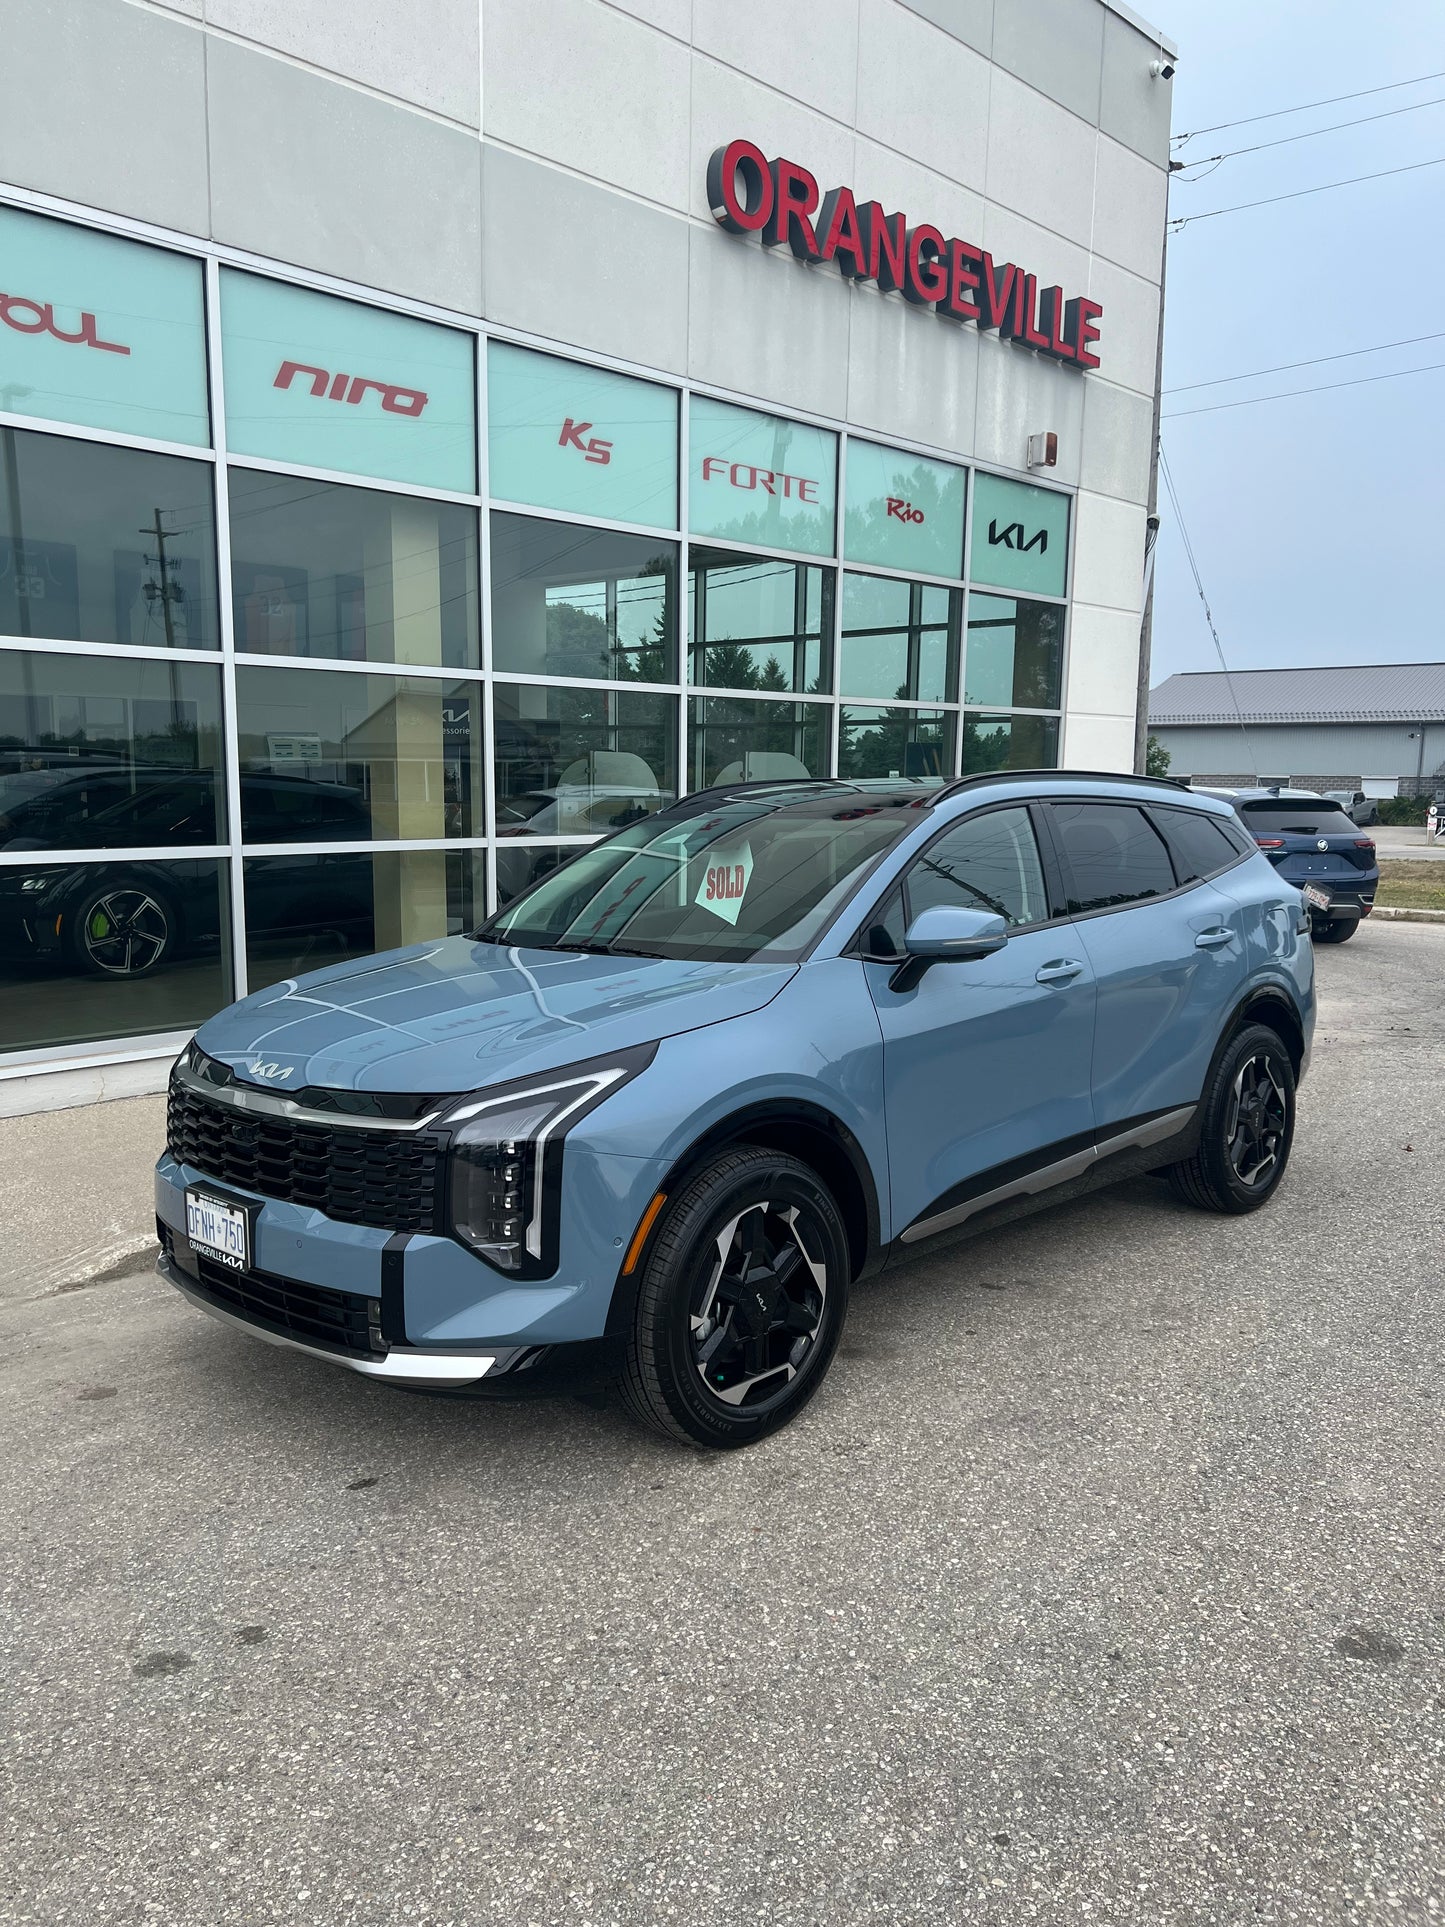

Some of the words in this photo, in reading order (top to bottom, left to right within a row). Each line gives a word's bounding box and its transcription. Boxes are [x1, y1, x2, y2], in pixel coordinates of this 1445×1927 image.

[708, 139, 1103, 370] ORANGEVILLE
[0, 293, 130, 355] OUL
[558, 417, 613, 465] K5
[703, 457, 820, 505] FORTE
[886, 497, 925, 525] Rio
[988, 518, 1048, 555] KIA
[706, 864, 745, 901] SOLD
[249, 1060, 295, 1081] KIA
[189, 1240, 222, 1262] ORANGEVILLE
[222, 1253, 243, 1271] KIA
